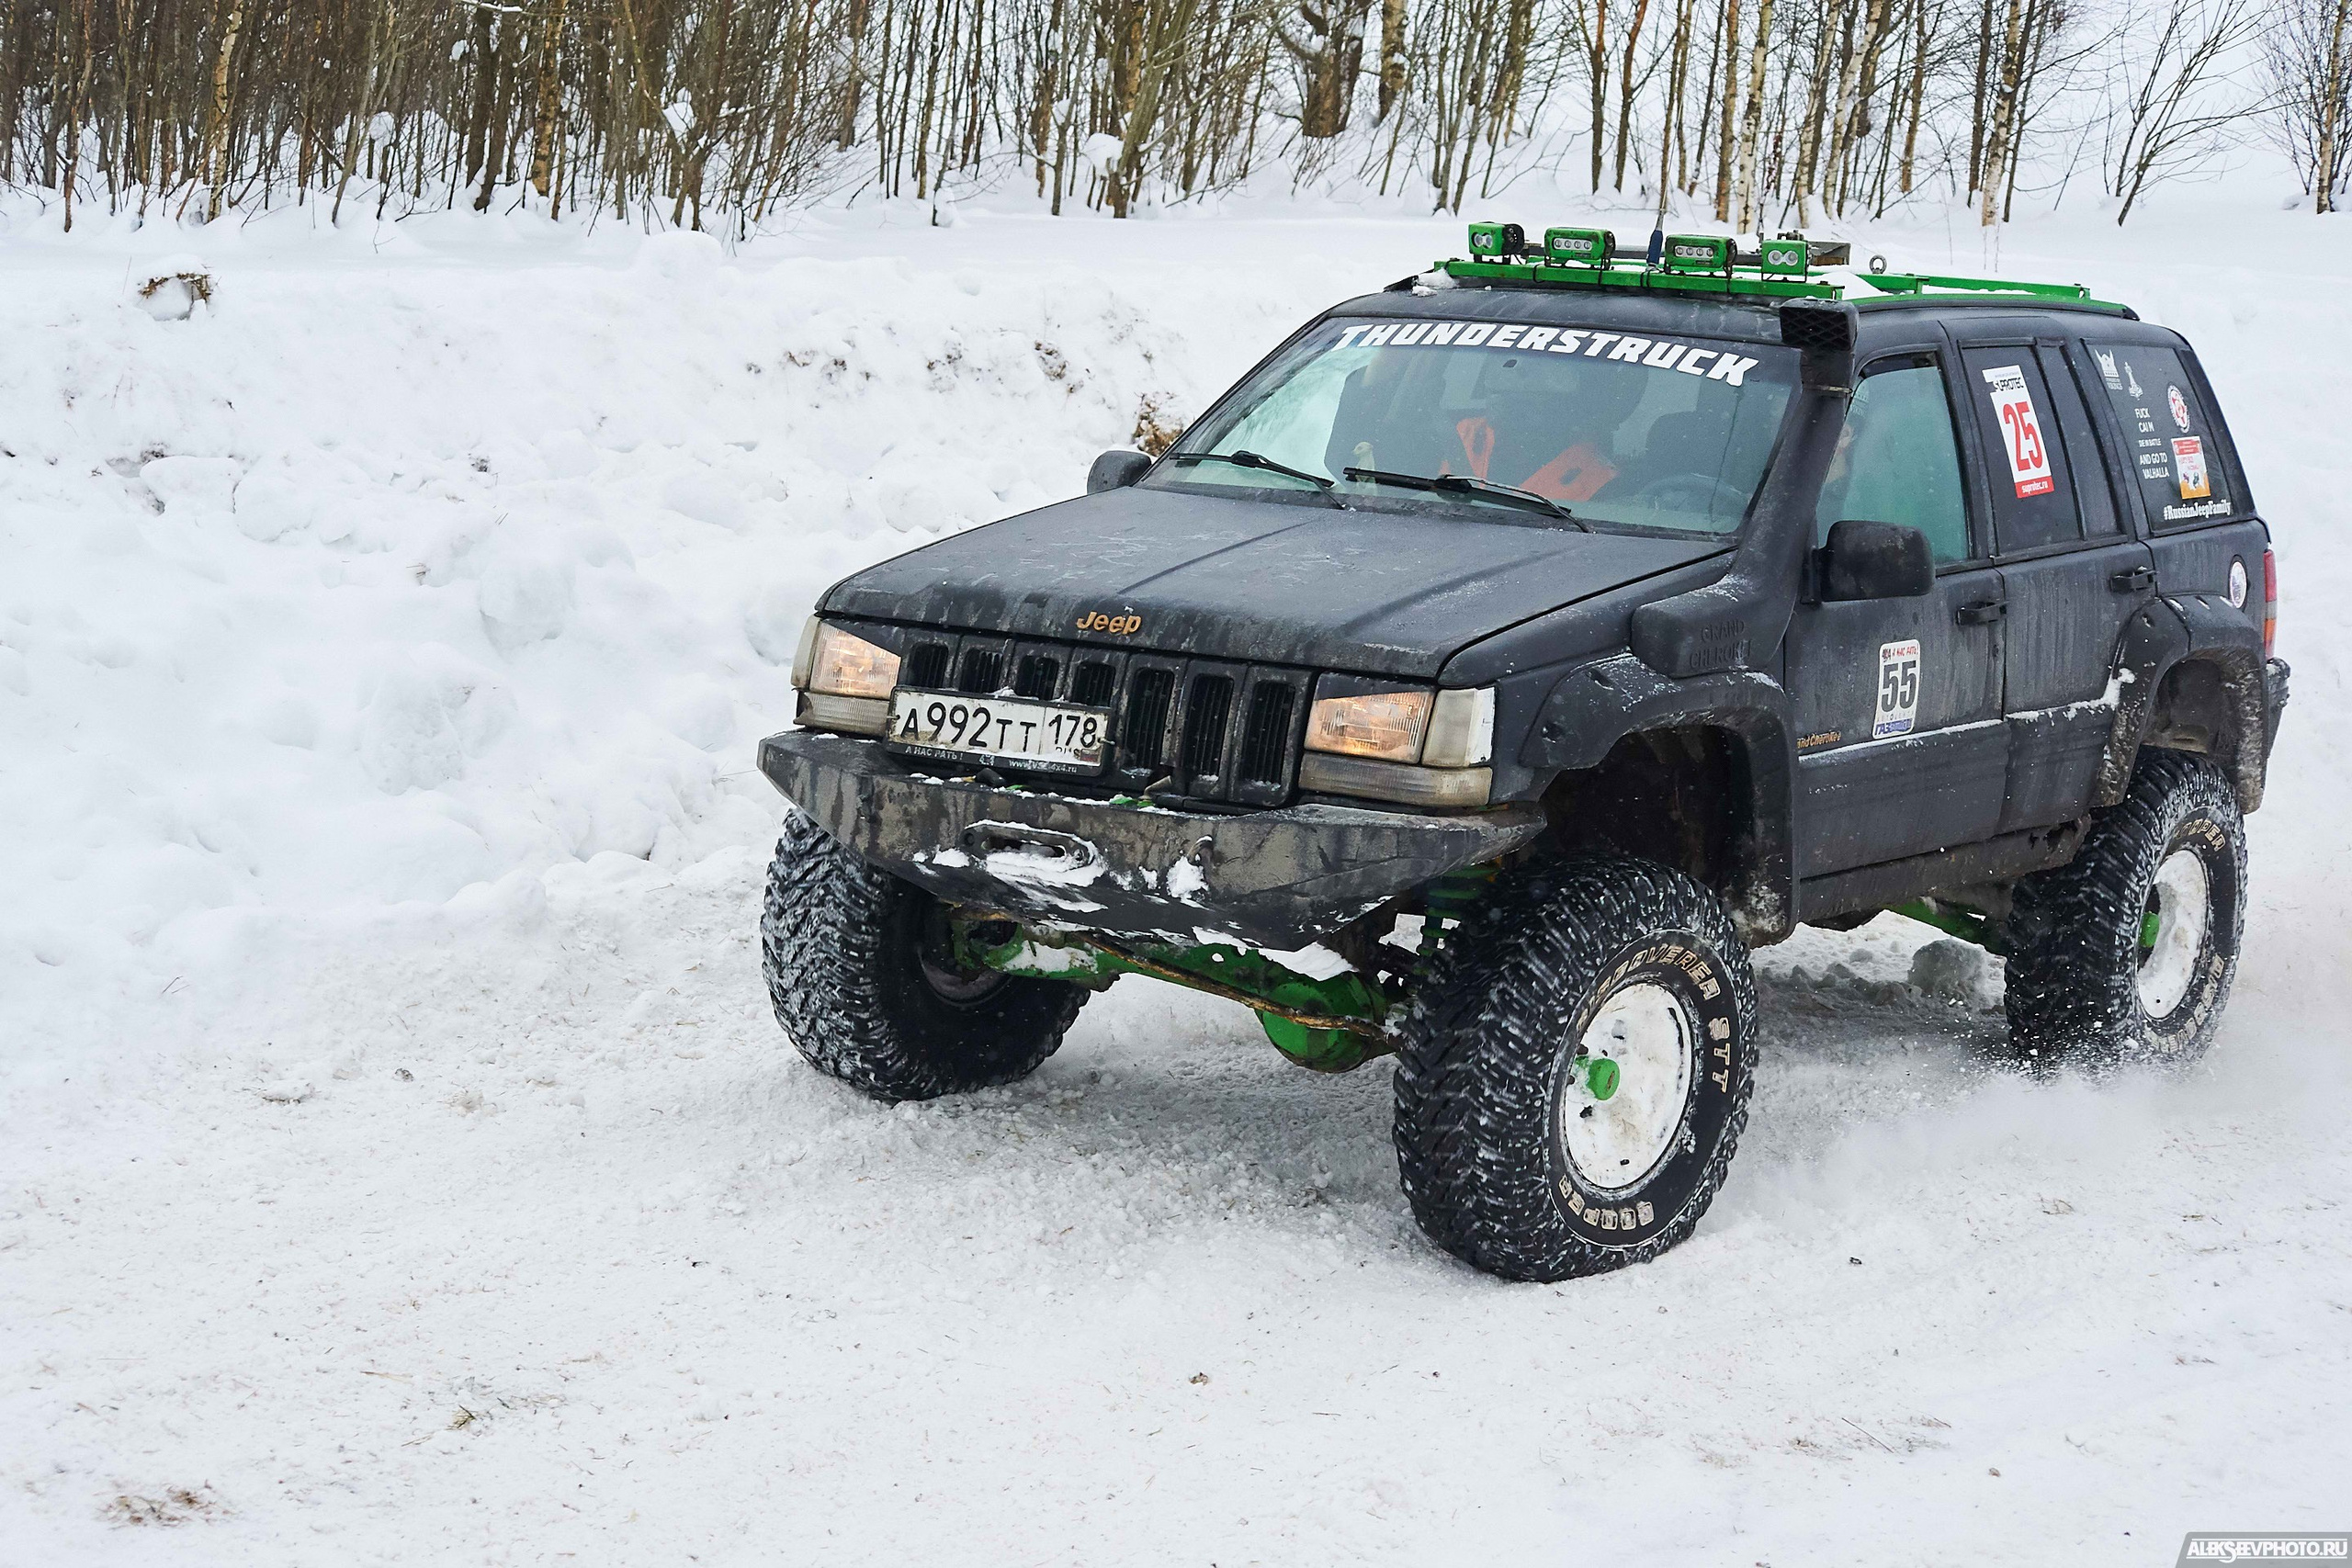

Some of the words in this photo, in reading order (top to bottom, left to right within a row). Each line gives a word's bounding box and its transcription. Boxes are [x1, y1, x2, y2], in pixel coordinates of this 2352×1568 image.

[1331, 322, 1759, 387] THUNDERSTRUCK
[2134, 408, 2151, 419] FUCK
[2002, 400, 2043, 471] 25
[2140, 454, 2152, 466] AND
[2151, 453, 2160, 464] GO
[2160, 452, 2168, 463] TO
[2142, 466, 2170, 479] VALHALLA
[2021, 479, 2049, 495] suprotec.ru
[2163, 499, 2232, 521] #RussianJeepFamily
[1076, 610, 1143, 636] Jeep
[1701, 618, 1746, 644] GRAND
[1881, 660, 1917, 713] 55
[1048, 713, 1098, 749] 178
[1558, 1173, 1656, 1231] COOPER
